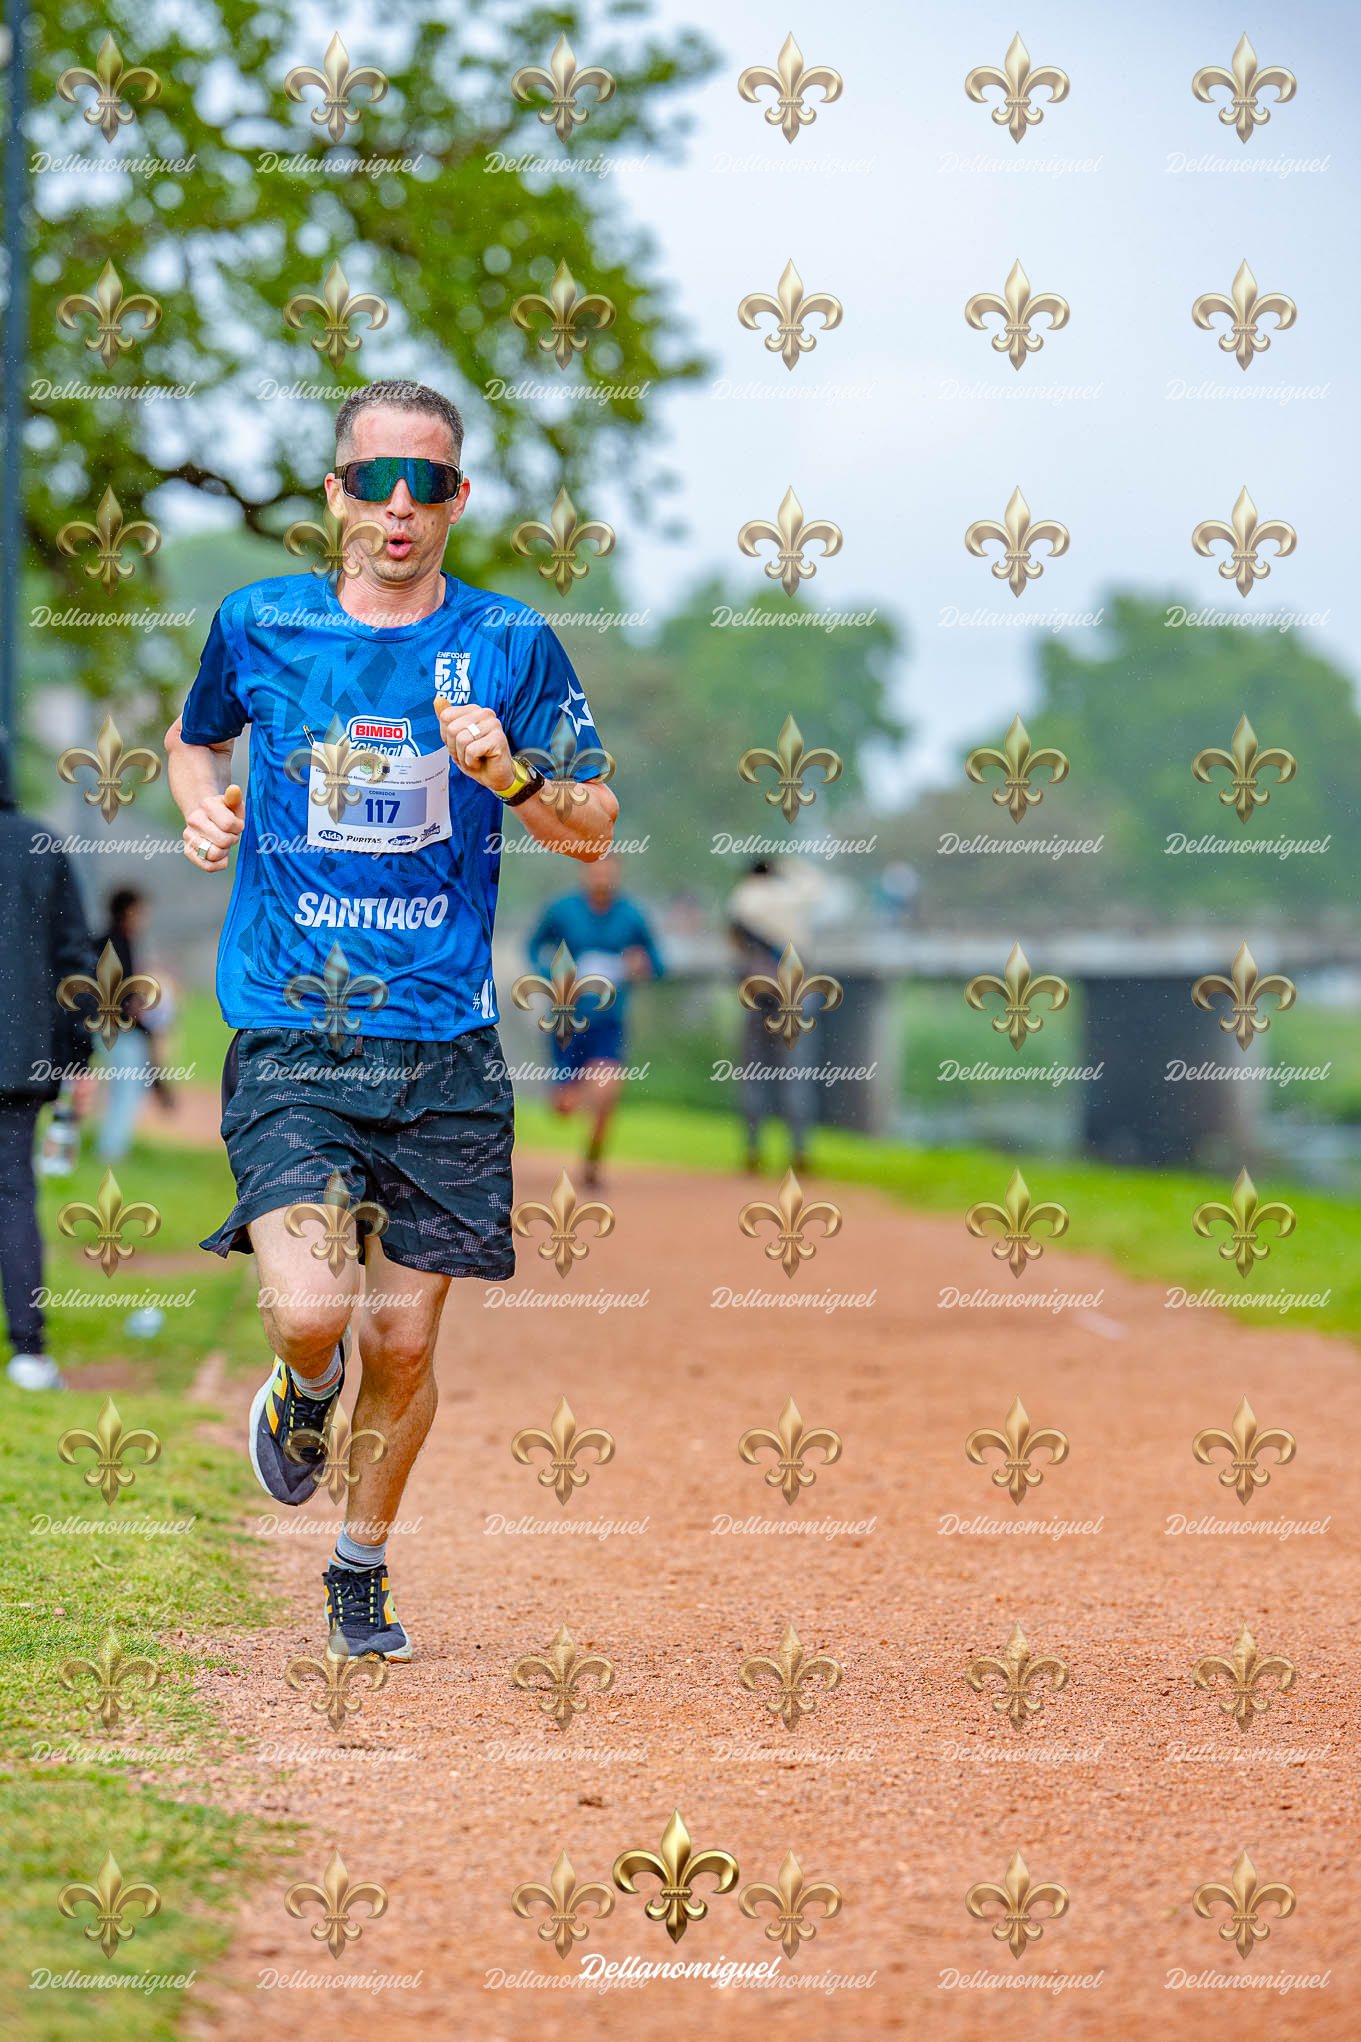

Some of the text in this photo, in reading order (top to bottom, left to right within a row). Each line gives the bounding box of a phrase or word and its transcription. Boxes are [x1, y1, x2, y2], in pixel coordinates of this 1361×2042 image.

[355, 724, 404, 739] BIMBO
[365, 798, 401, 824] 117
[320, 829, 342, 842] Aida
[346, 835, 382, 844] PURITAS
[294, 892, 449, 930] SANTIAGO
